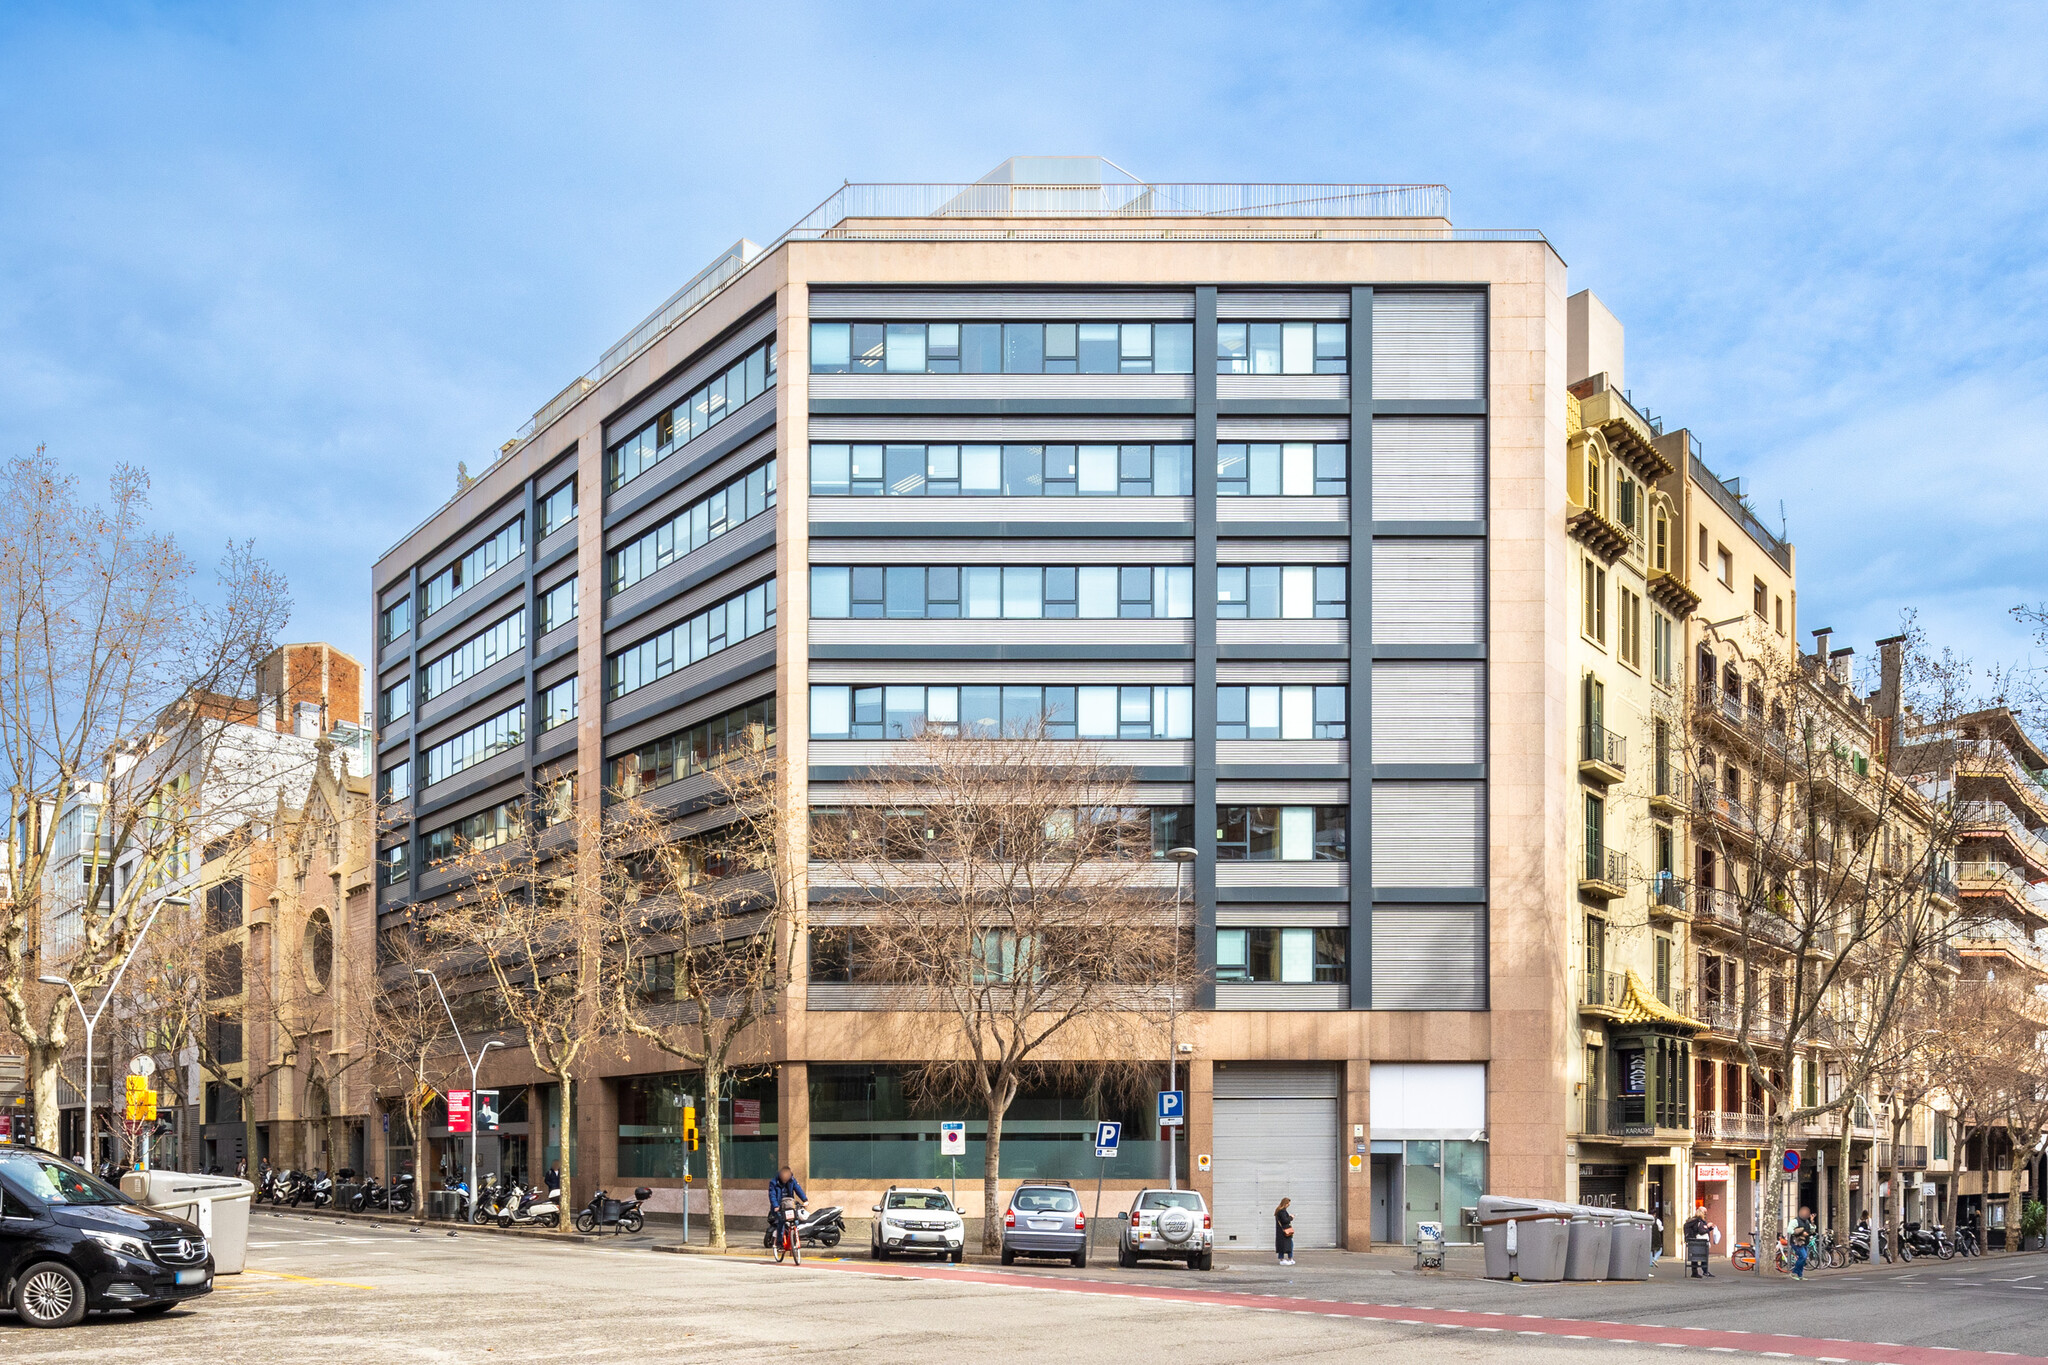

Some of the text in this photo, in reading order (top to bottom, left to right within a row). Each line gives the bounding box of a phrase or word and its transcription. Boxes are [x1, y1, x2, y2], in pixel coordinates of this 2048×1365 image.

[1630, 1053, 1646, 1091] KARAOKE
[1163, 1094, 1178, 1114] P
[1100, 1125, 1116, 1145] P
[1625, 1127, 1654, 1135] KARAOKE
[1579, 1193, 1617, 1209] ARAOKE
